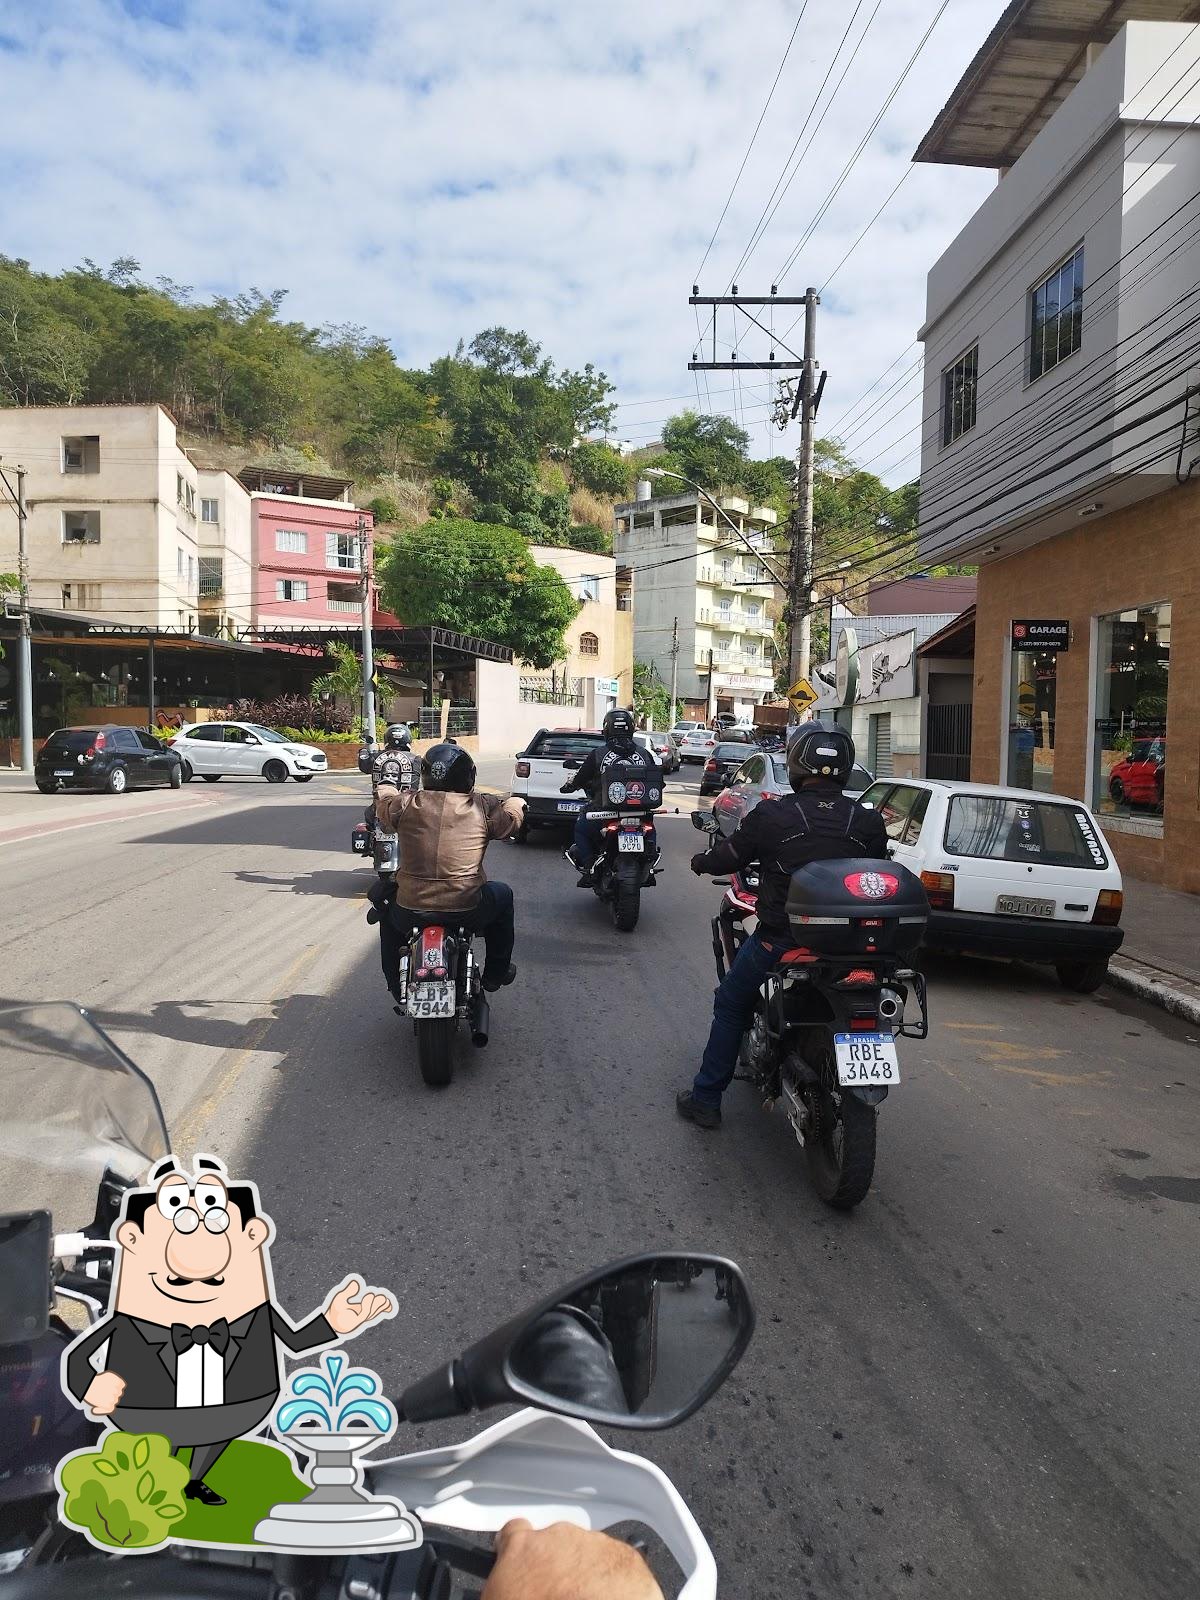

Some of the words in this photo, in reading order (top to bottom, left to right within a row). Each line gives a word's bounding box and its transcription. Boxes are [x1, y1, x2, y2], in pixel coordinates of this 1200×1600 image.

[1029, 626, 1068, 634] GARAGE
[412, 1001, 449, 1016] 7944
[849, 1044, 884, 1061] RBE
[845, 1062, 893, 1080] 3A48
